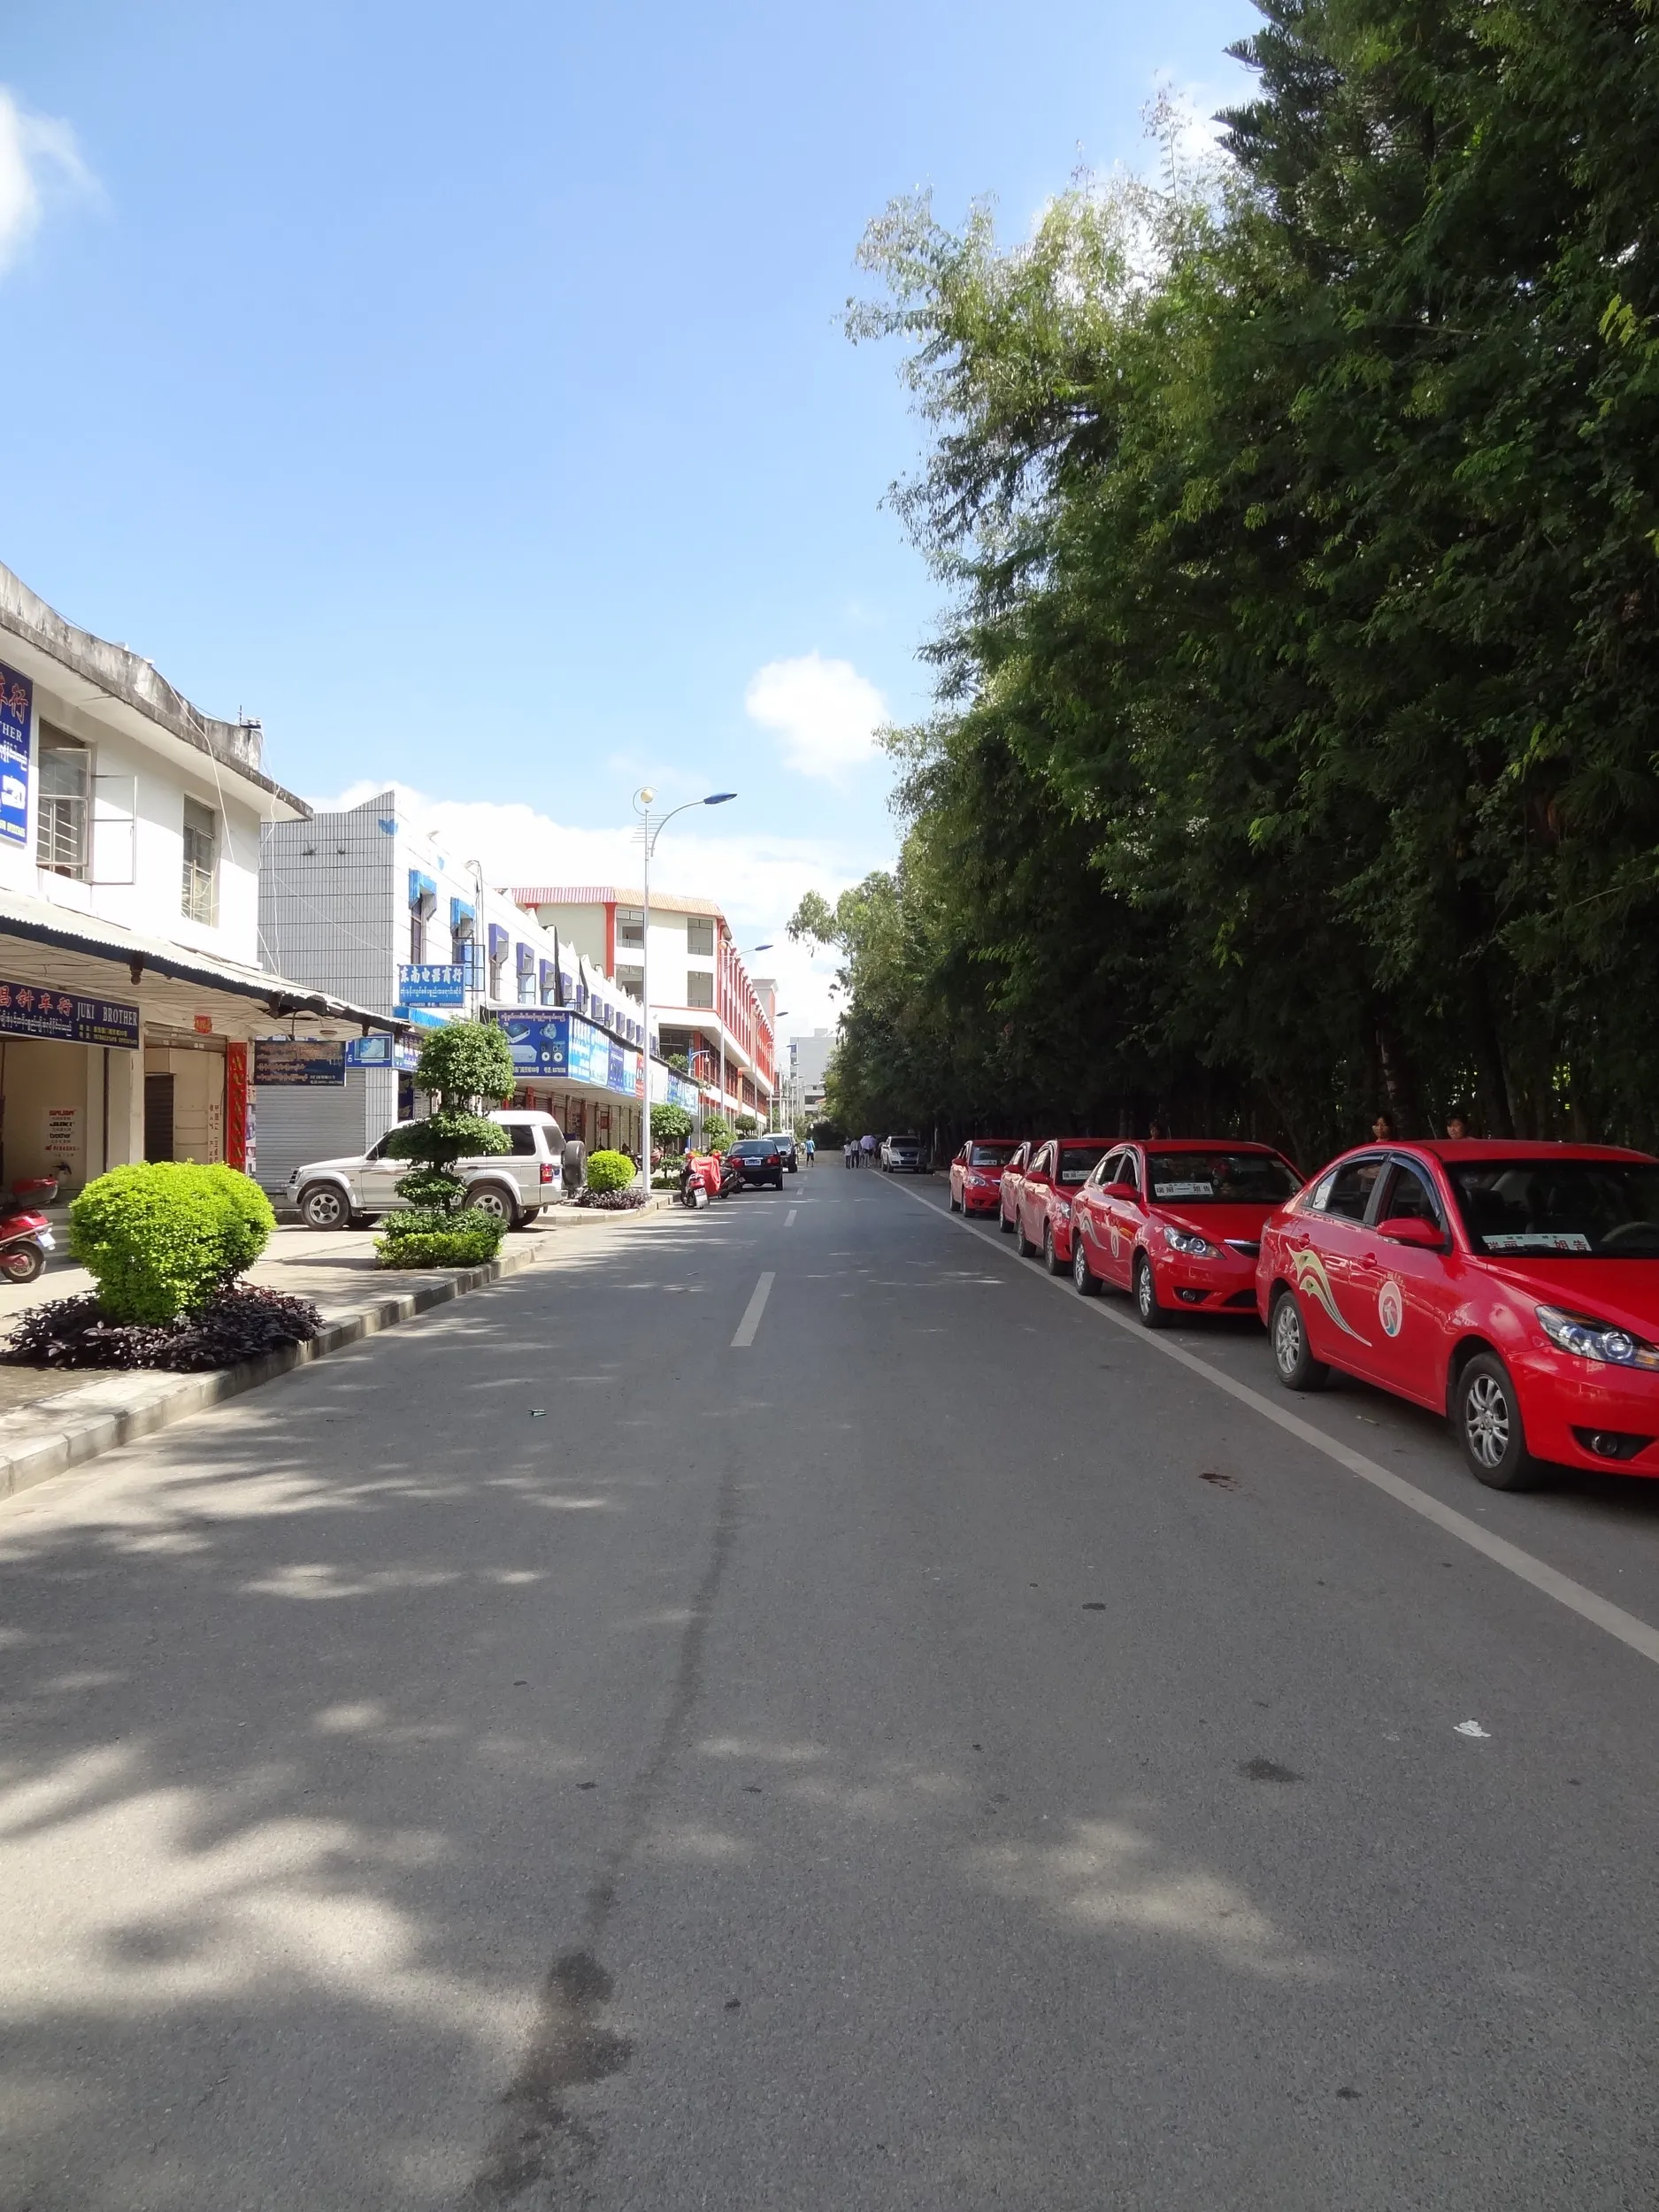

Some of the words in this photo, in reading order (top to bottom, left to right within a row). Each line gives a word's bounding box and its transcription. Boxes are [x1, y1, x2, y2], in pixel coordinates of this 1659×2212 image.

[400, 966, 463, 984] 东南电器商行
[76, 1002, 95, 1021] JUKI
[103, 1007, 137, 1026] BROTHER
